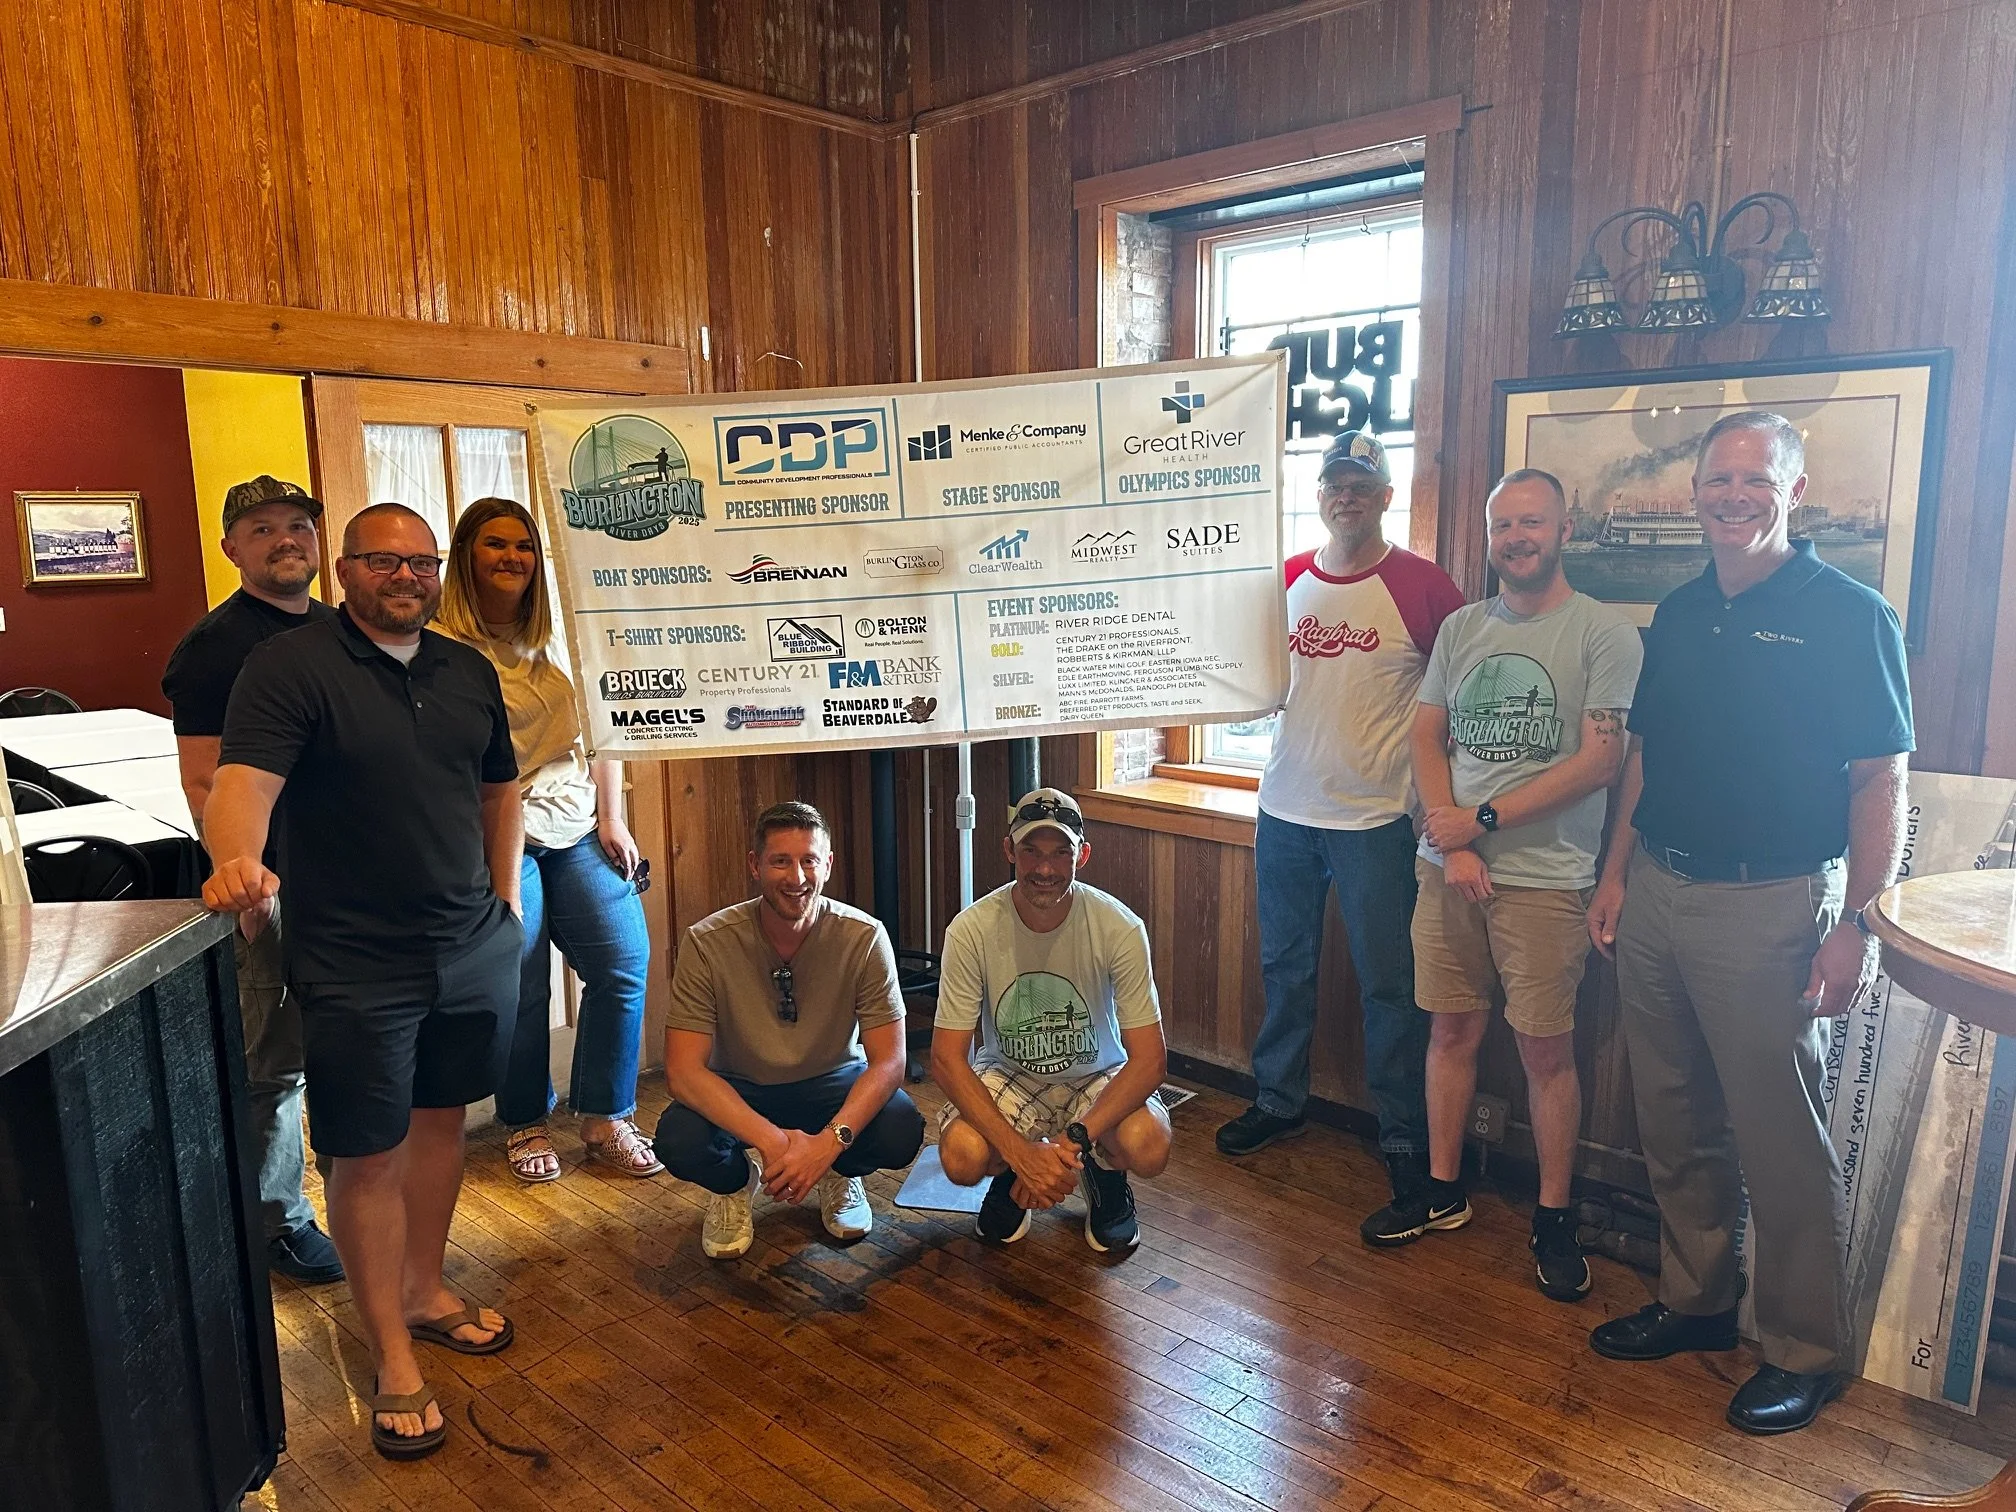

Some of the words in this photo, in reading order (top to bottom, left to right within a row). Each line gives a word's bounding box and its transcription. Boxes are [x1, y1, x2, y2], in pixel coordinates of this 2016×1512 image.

[960, 428, 1005, 443] Menke
[1006, 423, 1022, 442] &
[1022, 423, 1086, 438] Company
[725, 418, 878, 475] CDP
[965, 445, 1002, 453] CERTIFIED
[1031, 439, 1083, 448] ACCOUNTANTS
[1163, 453, 1208, 464] HEALTH
[737, 477, 774, 485] COMMUNITY
[775, 475, 820, 483] DEVELOPMENT
[821, 472, 873, 481] PROFESSIONALS
[1118, 470, 1190, 494] OLYMPICS
[1194, 463, 1262, 488] SPONSOR
[942, 485, 988, 507] STAGE
[992, 480, 1061, 503] SPONSOR
[561, 478, 706, 530] BURLINGTON
[725, 496, 817, 520] PRESENTING
[821, 492, 890, 514] SPONSOR
[678, 516, 700, 527] 2025
[609, 526, 638, 539] RIVER
[641, 521, 666, 537] DAYS
[1167, 523, 1240, 550] SADE
[1071, 544, 1138, 559] MIDWEST
[1089, 555, 1119, 564] REALTY
[1182, 546, 1223, 557] SUITES
[753, 566, 848, 583] BRENNAN
[968, 559, 1043, 575] ClearWealth
[592, 568, 628, 587] BOAT
[631, 565, 712, 586] SPONSORS:
[987, 597, 1035, 618] EVENT
[1039, 591, 1119, 614] SPONSORS:
[877, 616, 927, 627] BOLTON
[989, 620, 1050, 638] PLATINUM:
[1055, 617, 1090, 629] RIVER
[1093, 614, 1129, 626] RIDGE
[1131, 611, 1176, 623] DENTAL
[606, 627, 663, 647] T-SHIRT
[667, 624, 747, 645] SPONSORS:
[777, 633, 802, 641] BLUE
[878, 627, 888, 636] &
[890, 625, 927, 635] MENK
[1289, 614, 1379, 658] Ragbrai
[782, 639, 818, 648] RIBBON
[789, 645, 832, 654] BUILDING
[990, 642, 1024, 658] GOLD:
[1055, 634, 1097, 645] CENTURY
[1098, 633, 1107, 641] 21
[1056, 646, 1074, 654] THE
[1075, 643, 1106, 653] DRAKE
[1157, 648, 1176, 656] LLLP
[882, 656, 942, 673] BANK
[1057, 666, 1081, 674] BLACK
[1082, 664, 1107, 672] WATER
[1109, 661, 1125, 669] MINI
[1148, 658, 1181, 667] EASTERN
[1134, 667, 1174, 676] FERGUSON
[1175, 664, 1214, 672] PLUMBING
[606, 669, 687, 692] BRUECK
[697, 664, 794, 683] CENTURY
[828, 660, 882, 689] F&M
[992, 671, 1034, 688] SILVER:
[1109, 678, 1148, 686] KLINGNER
[1153, 674, 1197, 682] ASSOCIATES
[700, 689, 736, 698] Property
[737, 685, 791, 694] Professionals
[1178, 681, 1207, 689] DENTAL
[604, 690, 633, 700] BUILDS
[635, 689, 685, 699] BURLINGTON
[1090, 697, 1120, 705] PARROTT
[823, 698, 889, 713] STANDARD
[892, 698, 903, 709] OF
[995, 704, 1041, 721] BRONZE:
[1060, 705, 1098, 713] PREFERRED
[610, 708, 706, 727] MAGEL'S
[822, 712, 908, 727] BEAVERDALE
[1081, 712, 1104, 720] QUEEN
[624, 733, 630, 741] &
[631, 732, 663, 741] DRILLING
[664, 731, 698, 739] SERVICES
[626, 726, 663, 734] CONCRETE
[664, 725, 694, 733] CUTTING
[1450, 709, 1564, 751] BURLINGTON
[1469, 746, 1491, 760] RIVER
[1494, 750, 1517, 760] DAYS
[1526, 749, 1550, 763] 2025
[1862, 991, 1881, 1020] five
[1000, 1026, 1099, 1060] URLINGTON
[1076, 1055, 1098, 1065] 2025
[1854, 1023, 1876, 1084] hundred
[1021, 1061, 1046, 1073] RIVER
[1049, 1060, 1070, 1073] DAYS
[1850, 1089, 1866, 1135] seven
[1952, 1260, 1983, 1370] 123456789
[1912, 1338, 1932, 1370] For
